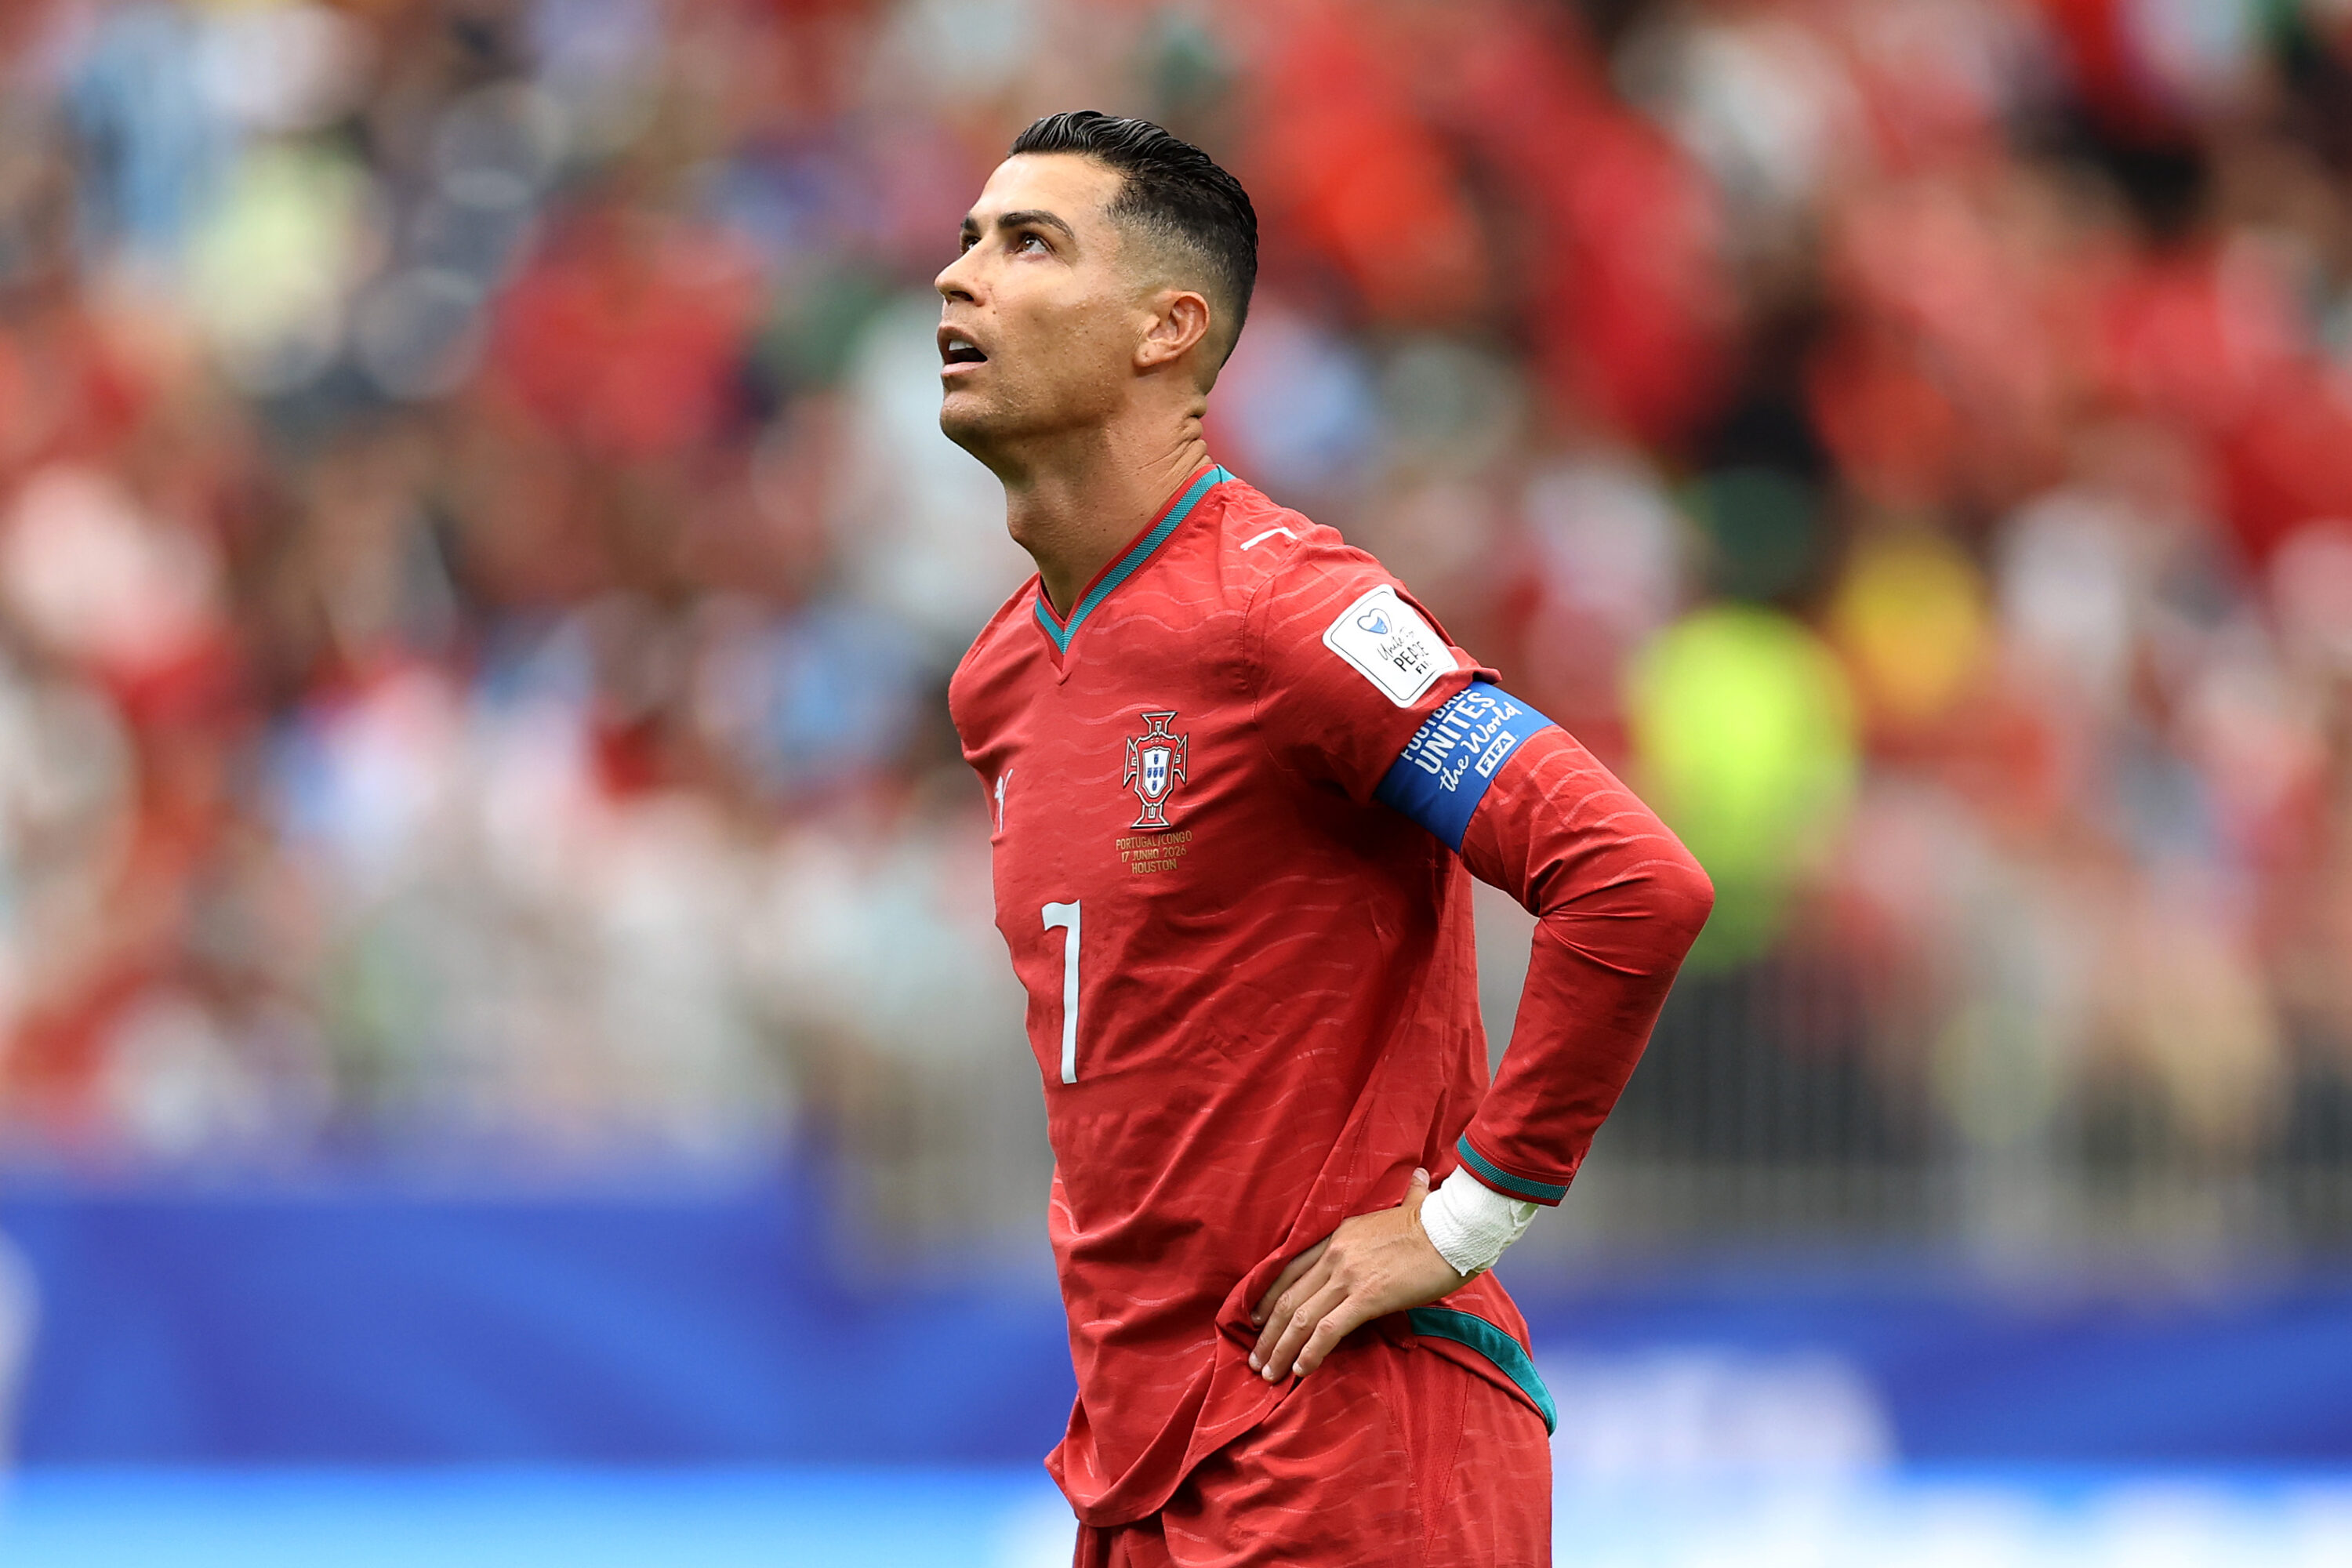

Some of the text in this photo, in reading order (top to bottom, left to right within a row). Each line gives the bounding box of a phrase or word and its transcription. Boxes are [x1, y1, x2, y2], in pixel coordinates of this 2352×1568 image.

[1393, 641, 1429, 672] PEAE
[1414, 691, 1496, 775] UNITES
[1439, 701, 1523, 793] the World
[1479, 735, 1513, 772] FIFA
[1116, 830, 1192, 851] PORTUGAL/CONGO
[1121, 844, 1187, 863] 17 JUNHO 2026
[1131, 858, 1177, 873] HOUSTON
[1041, 899, 1080, 1084] 7
